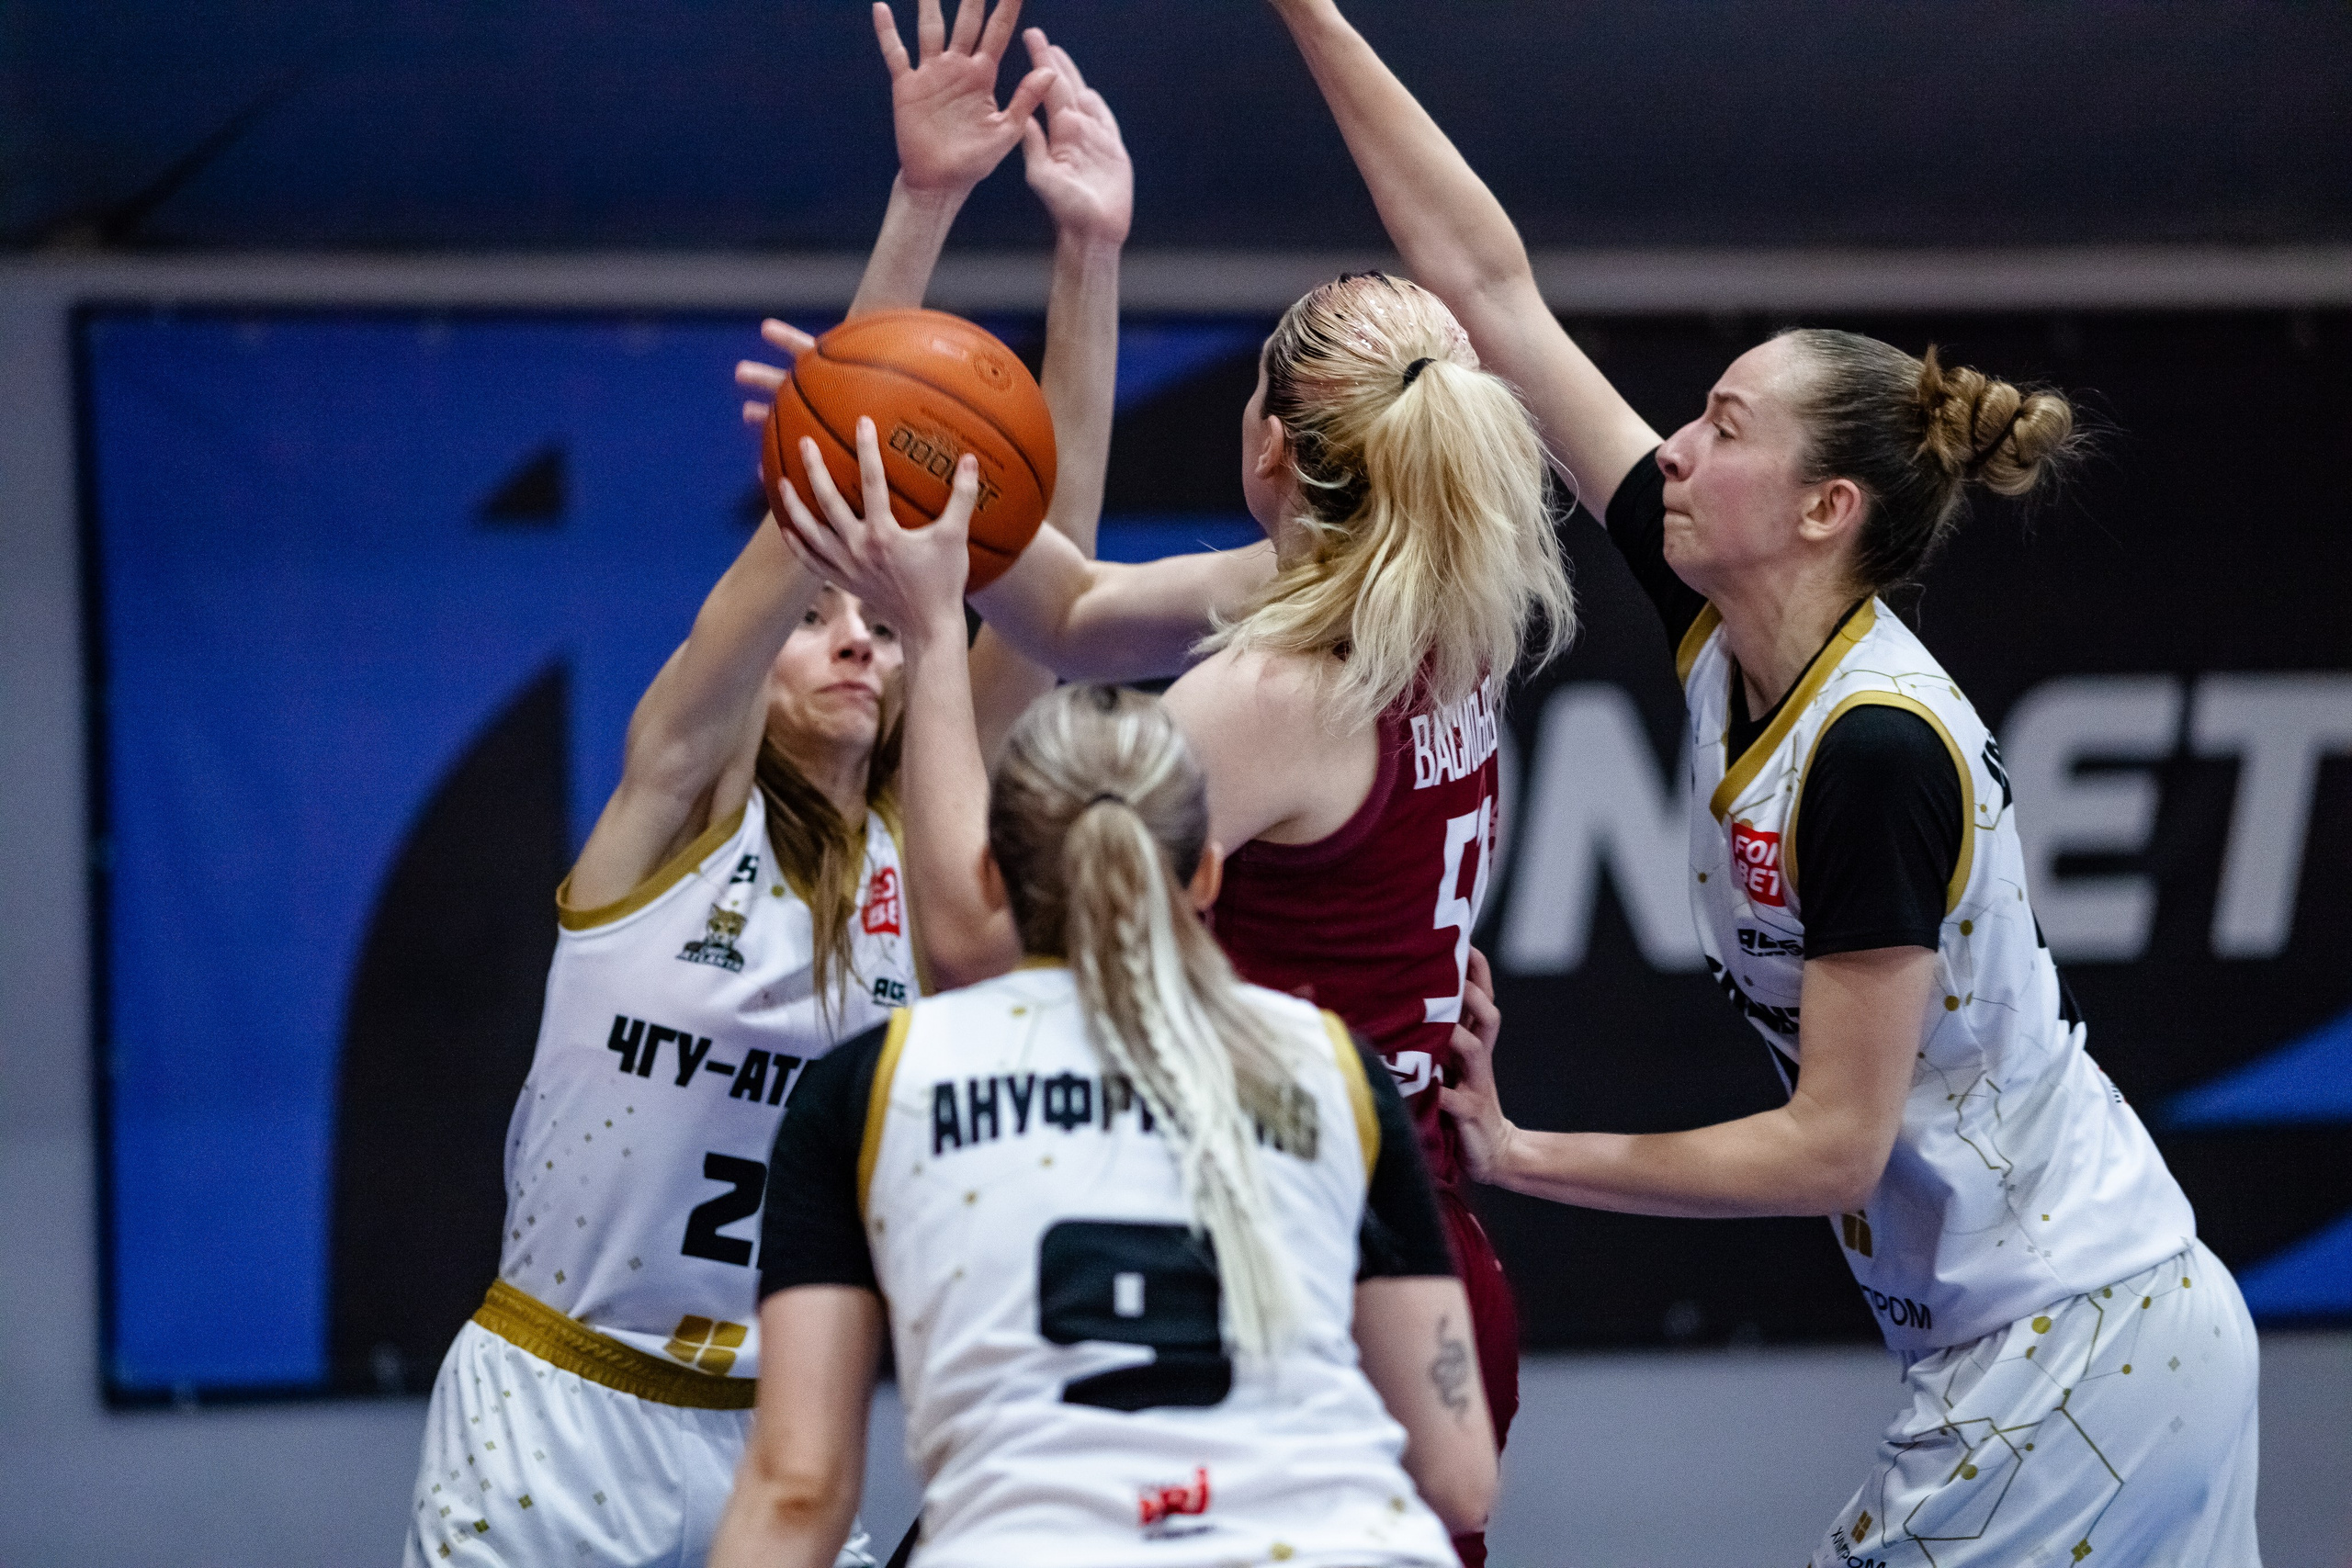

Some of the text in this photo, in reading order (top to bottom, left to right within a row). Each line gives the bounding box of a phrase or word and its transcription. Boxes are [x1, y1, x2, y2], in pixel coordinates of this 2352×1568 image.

[607, 1014, 808, 1108] ЧГУ-АТ
[681, 1152, 768, 1268] 2
[1036, 1217, 1234, 1412] 9
